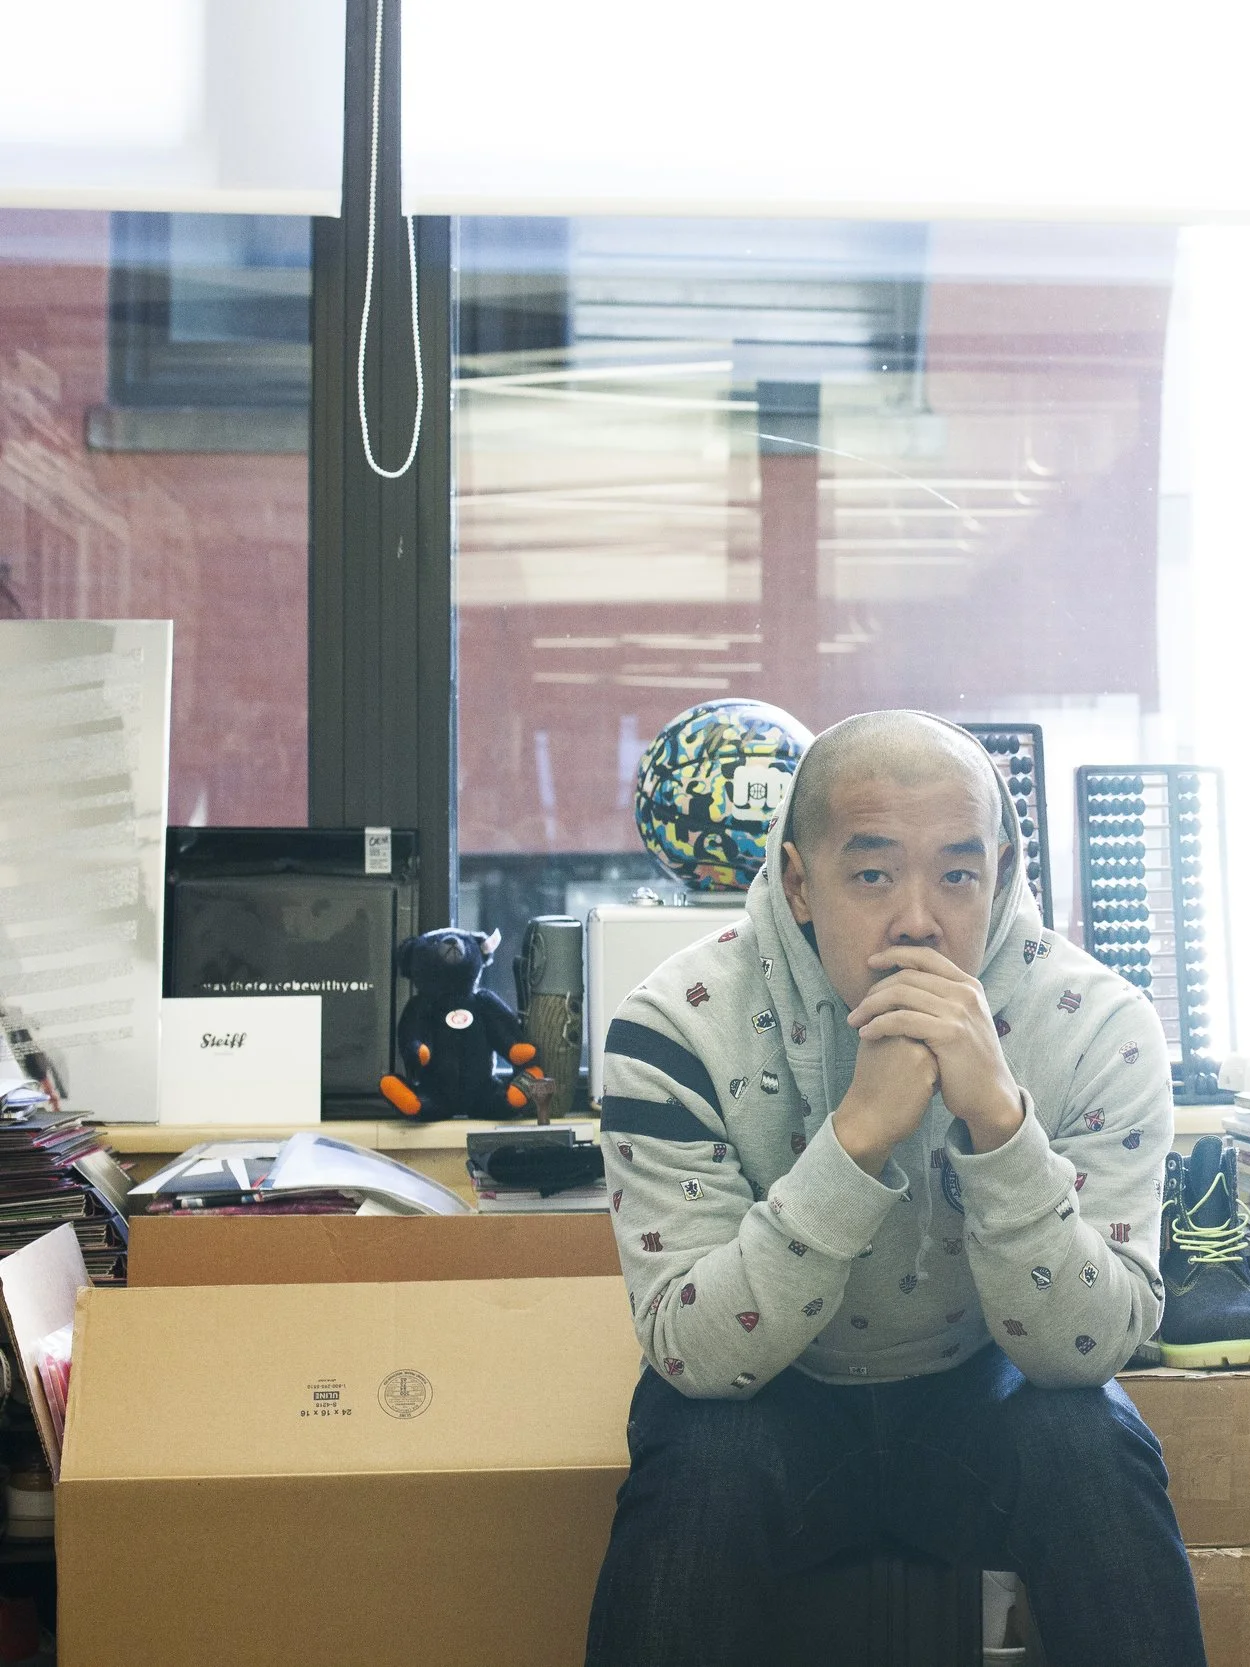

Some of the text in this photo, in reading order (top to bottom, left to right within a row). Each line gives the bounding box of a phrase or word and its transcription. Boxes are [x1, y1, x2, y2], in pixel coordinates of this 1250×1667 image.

[200, 1033, 248, 1049] Steiff
[315, 1392, 339, 1400] ULINE
[300, 1409, 310, 1417] 16
[321, 1408, 331, 1417] 16
[342, 1408, 352, 1416] 24
